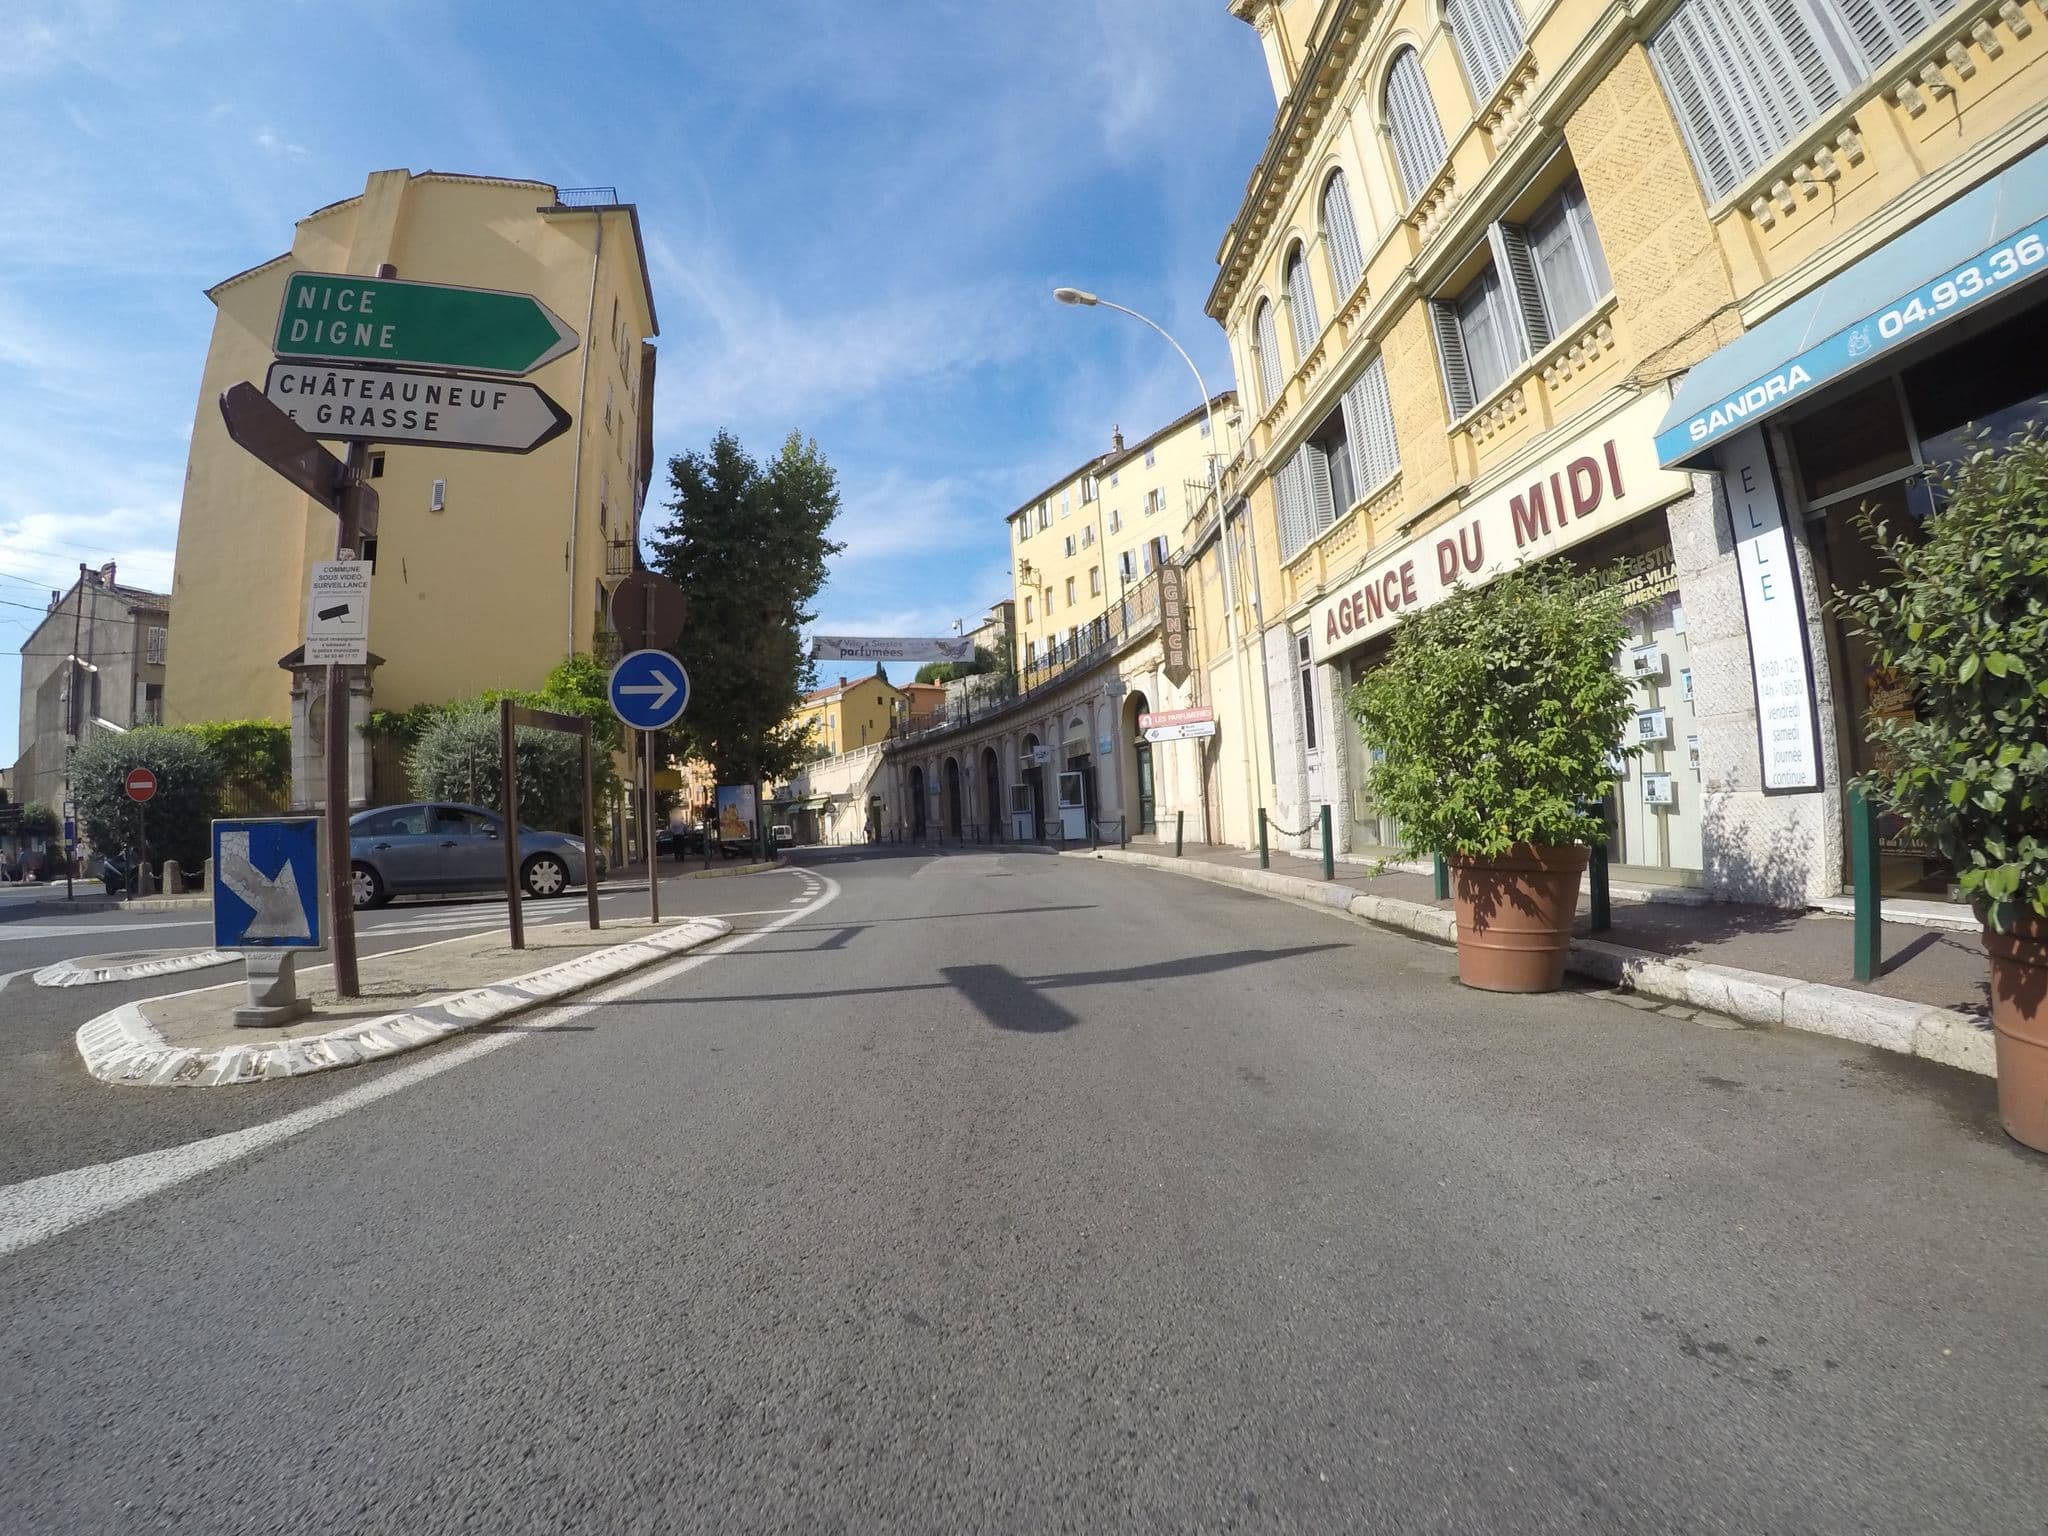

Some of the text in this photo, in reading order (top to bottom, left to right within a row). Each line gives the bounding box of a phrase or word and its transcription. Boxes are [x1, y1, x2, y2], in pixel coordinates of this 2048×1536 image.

[297, 286, 376, 314] NICE
[290, 319, 396, 348] DIGNE
[1689, 234, 2048, 442] SANDRA 04.93.36
[280, 372, 507, 411] CHÂTEAUNEUF
[316, 404, 440, 432] GRASSE
[1326, 439, 1626, 645] AGENCE DU MIDI
[1629, 545, 1675, 576] GESTIO
[1163, 569, 1184, 666] AGENCE
[840, 645, 904, 659] parfumées
[1155, 708, 1213, 724] LES PARFUMERIES
[1772, 768, 1807, 785] continue
